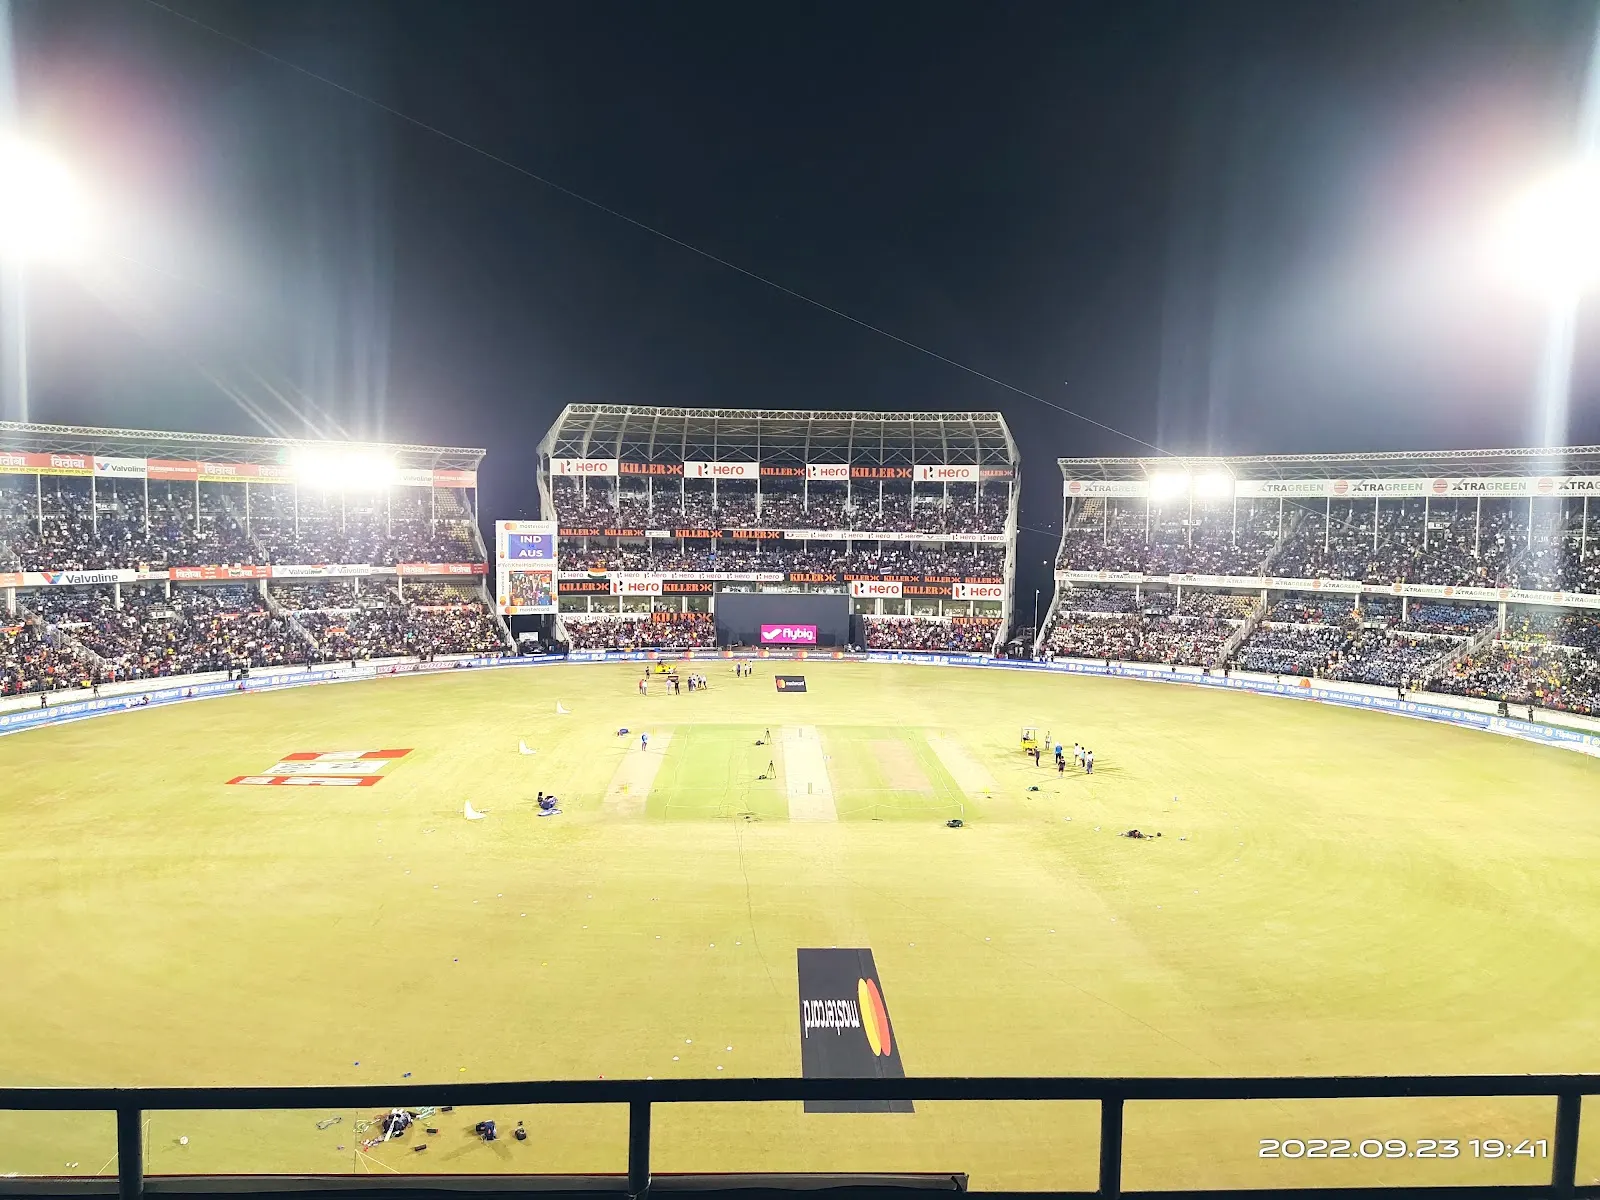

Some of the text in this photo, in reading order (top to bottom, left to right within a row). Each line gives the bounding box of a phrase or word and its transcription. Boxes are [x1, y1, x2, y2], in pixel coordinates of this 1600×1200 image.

[111, 464, 146, 472] Valvoline
[576, 462, 608, 472] Hero
[620, 462, 666, 474] KILLER
[713, 465, 744, 474] Hero
[761, 468, 793, 476] KILLER
[820, 468, 847, 476] Hero
[852, 467, 896, 478] KILLER
[938, 468, 970, 478] Hero
[1084, 481, 1137, 492] XTRAGREE
[1352, 480, 1423, 492] XTRAGREEN
[1452, 479, 1526, 491] XTRAGREEN
[676, 530, 710, 538] KILLER
[733, 530, 768, 538] KILLER
[66, 573, 118, 584] Valvoline
[790, 573, 824, 582] KILLER
[559, 583, 596, 591] KILLER
[628, 582, 659, 592] Hero
[664, 584, 700, 592] KILLER
[869, 585, 899, 594] Hero
[904, 586, 938, 595] KILLER
[970, 587, 1001, 596] Hero
[783, 628, 813, 640] flybig
[803, 1000, 860, 1038] mastercard
